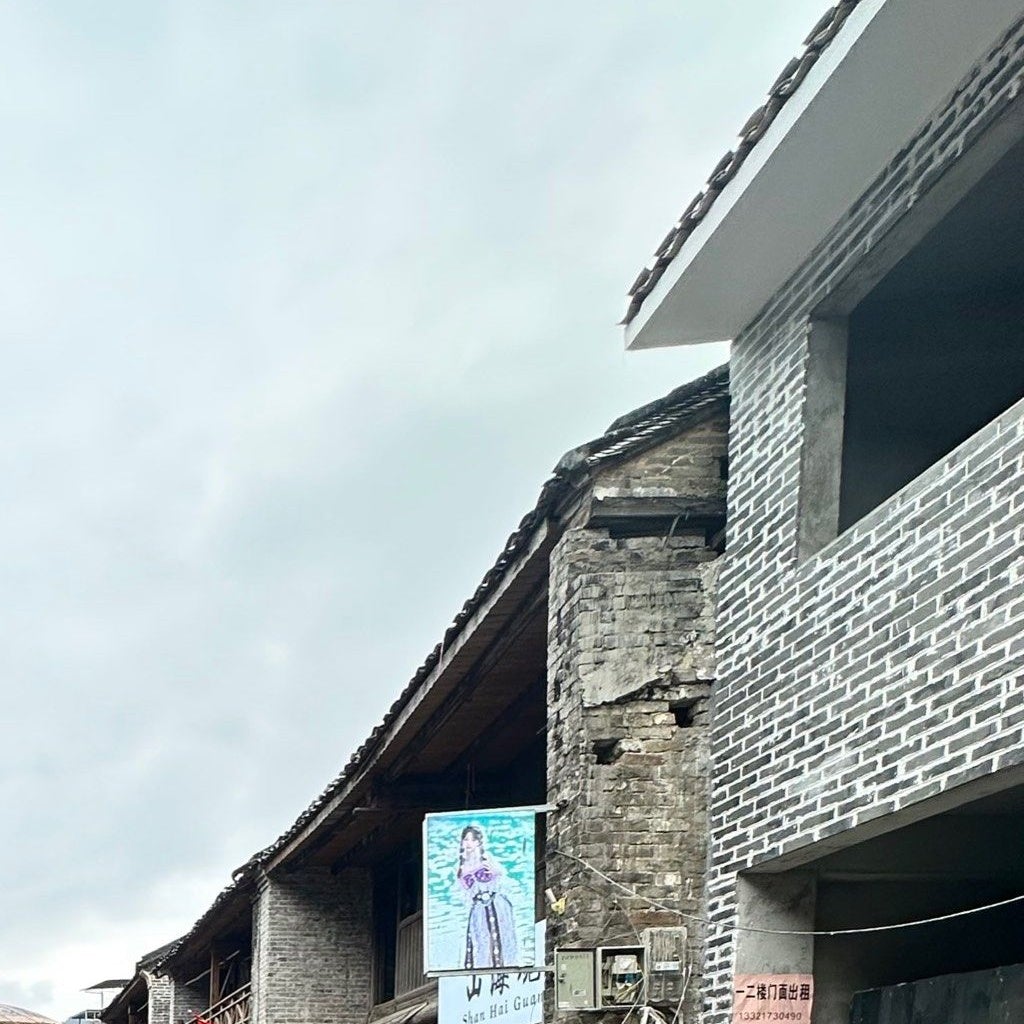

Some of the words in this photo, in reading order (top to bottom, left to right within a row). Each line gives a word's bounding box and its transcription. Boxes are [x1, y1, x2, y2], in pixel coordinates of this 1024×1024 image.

[735, 983, 810, 1001] 一二楼门面出租
[489, 1000, 509, 1019] Hai
